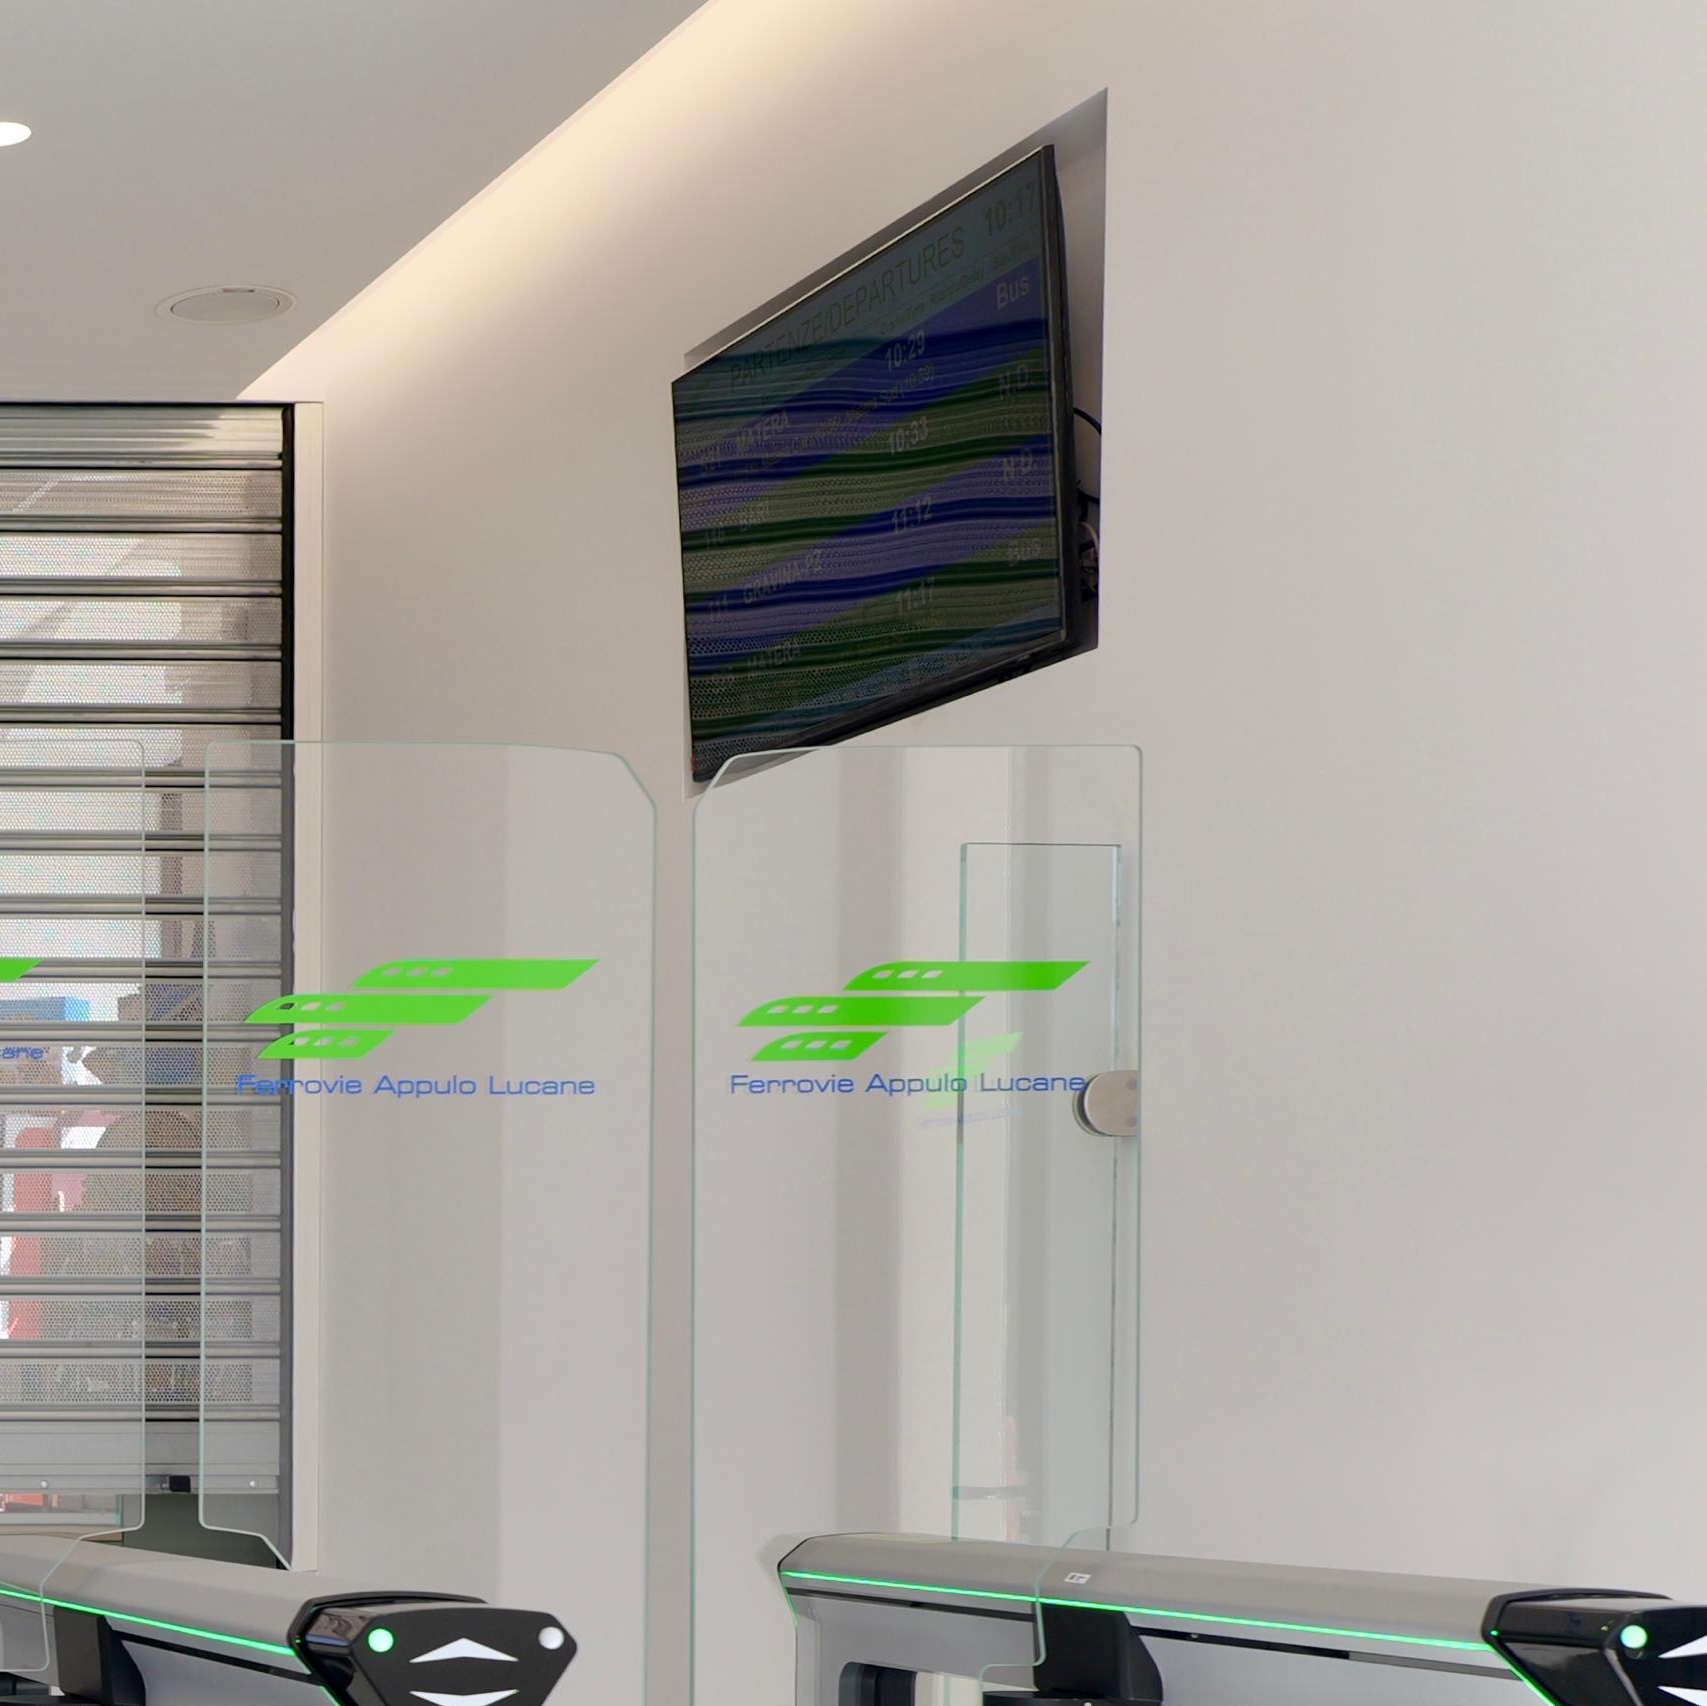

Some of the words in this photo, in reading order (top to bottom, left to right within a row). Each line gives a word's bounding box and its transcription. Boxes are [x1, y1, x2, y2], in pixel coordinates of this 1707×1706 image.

[984, 180, 1038, 238] 10:17
[885, 331, 927, 372] 10:29
[996, 275, 1031, 311] Bus
[236, 1073, 363, 1096] Ferrovie
[373, 1074, 477, 1098] Appulo
[489, 1075, 596, 1096] Lucane
[730, 1073, 854, 1095] Ferrovie
[864, 1073, 967, 1097] Appulo
[978, 1072, 1086, 1093] Lucane
